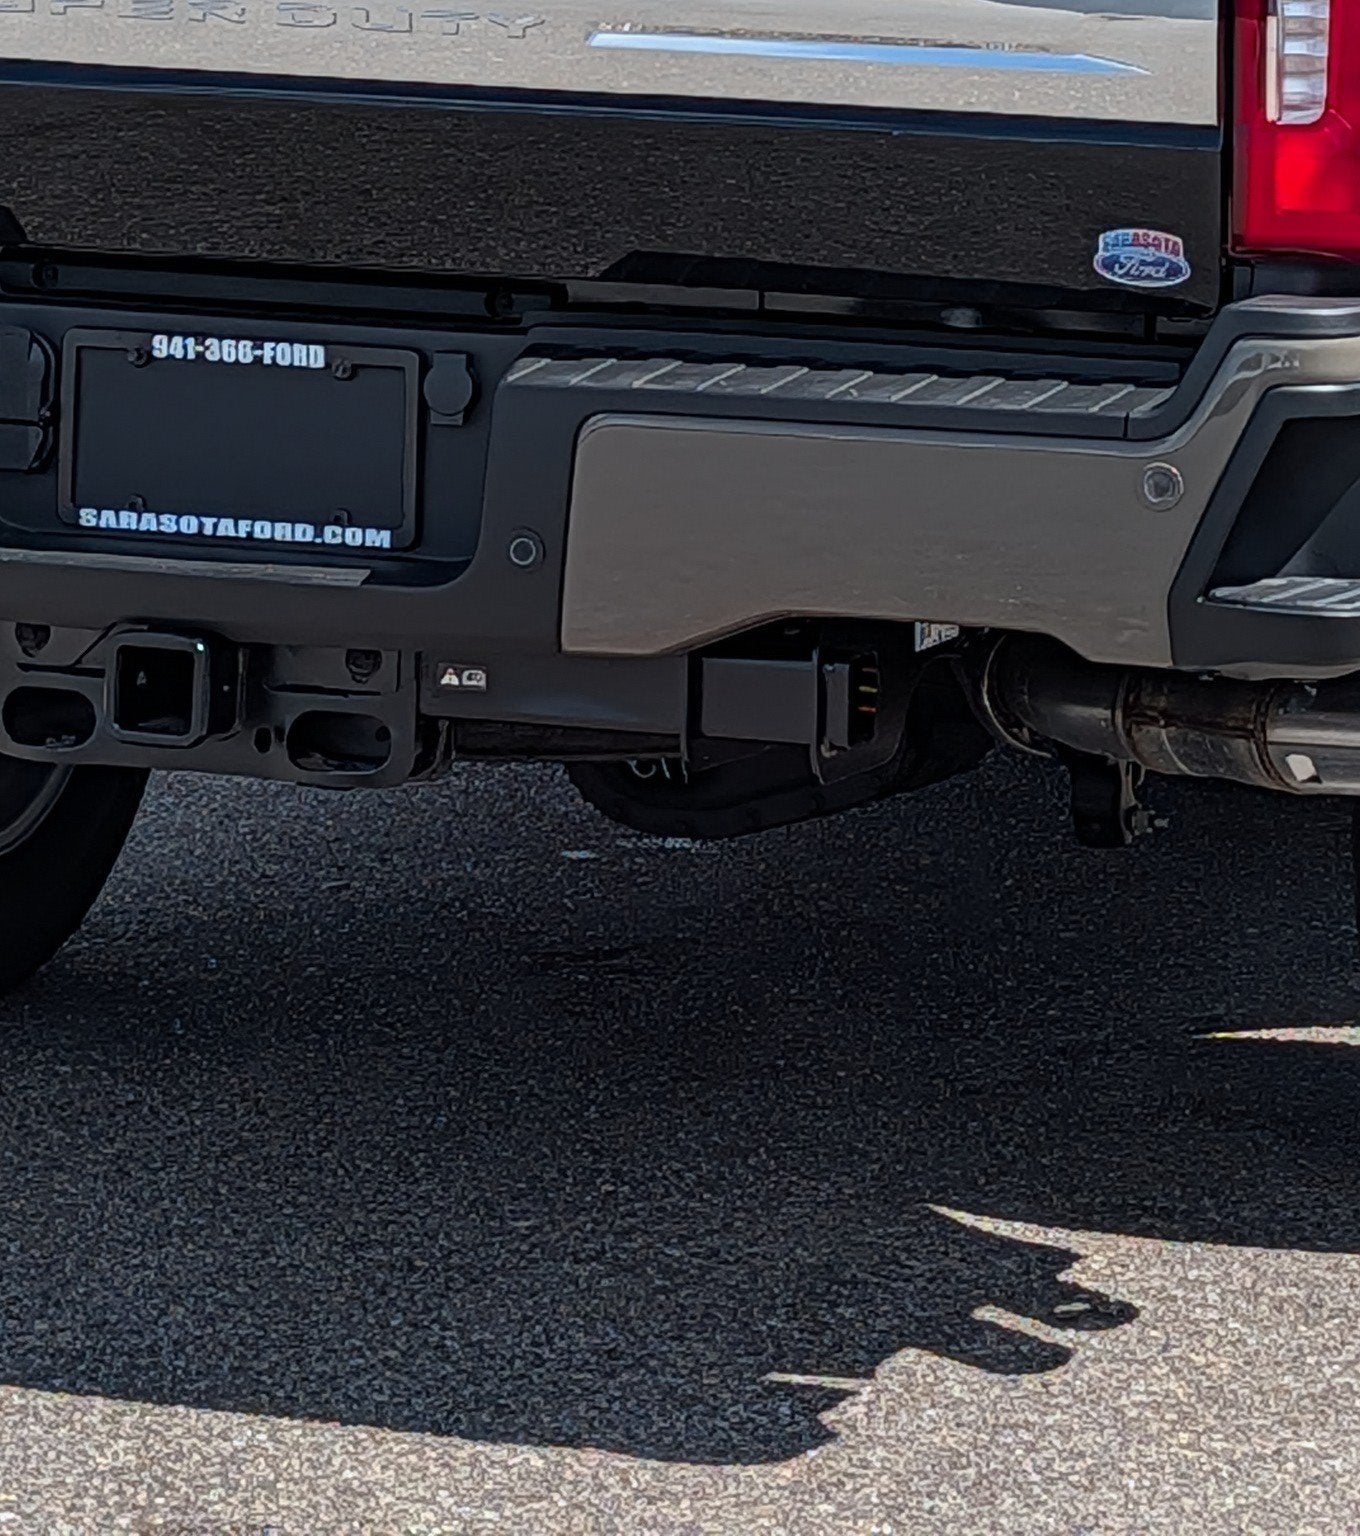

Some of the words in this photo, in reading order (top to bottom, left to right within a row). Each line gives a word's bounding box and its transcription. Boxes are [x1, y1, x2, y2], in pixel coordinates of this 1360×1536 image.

[277, 2, 545, 39] DUTY
[1115, 253, 1170, 278] Ford
[152, 334, 325, 369] 941-366-FORD
[79, 508, 391, 549] SARASOTAFORD.COM
